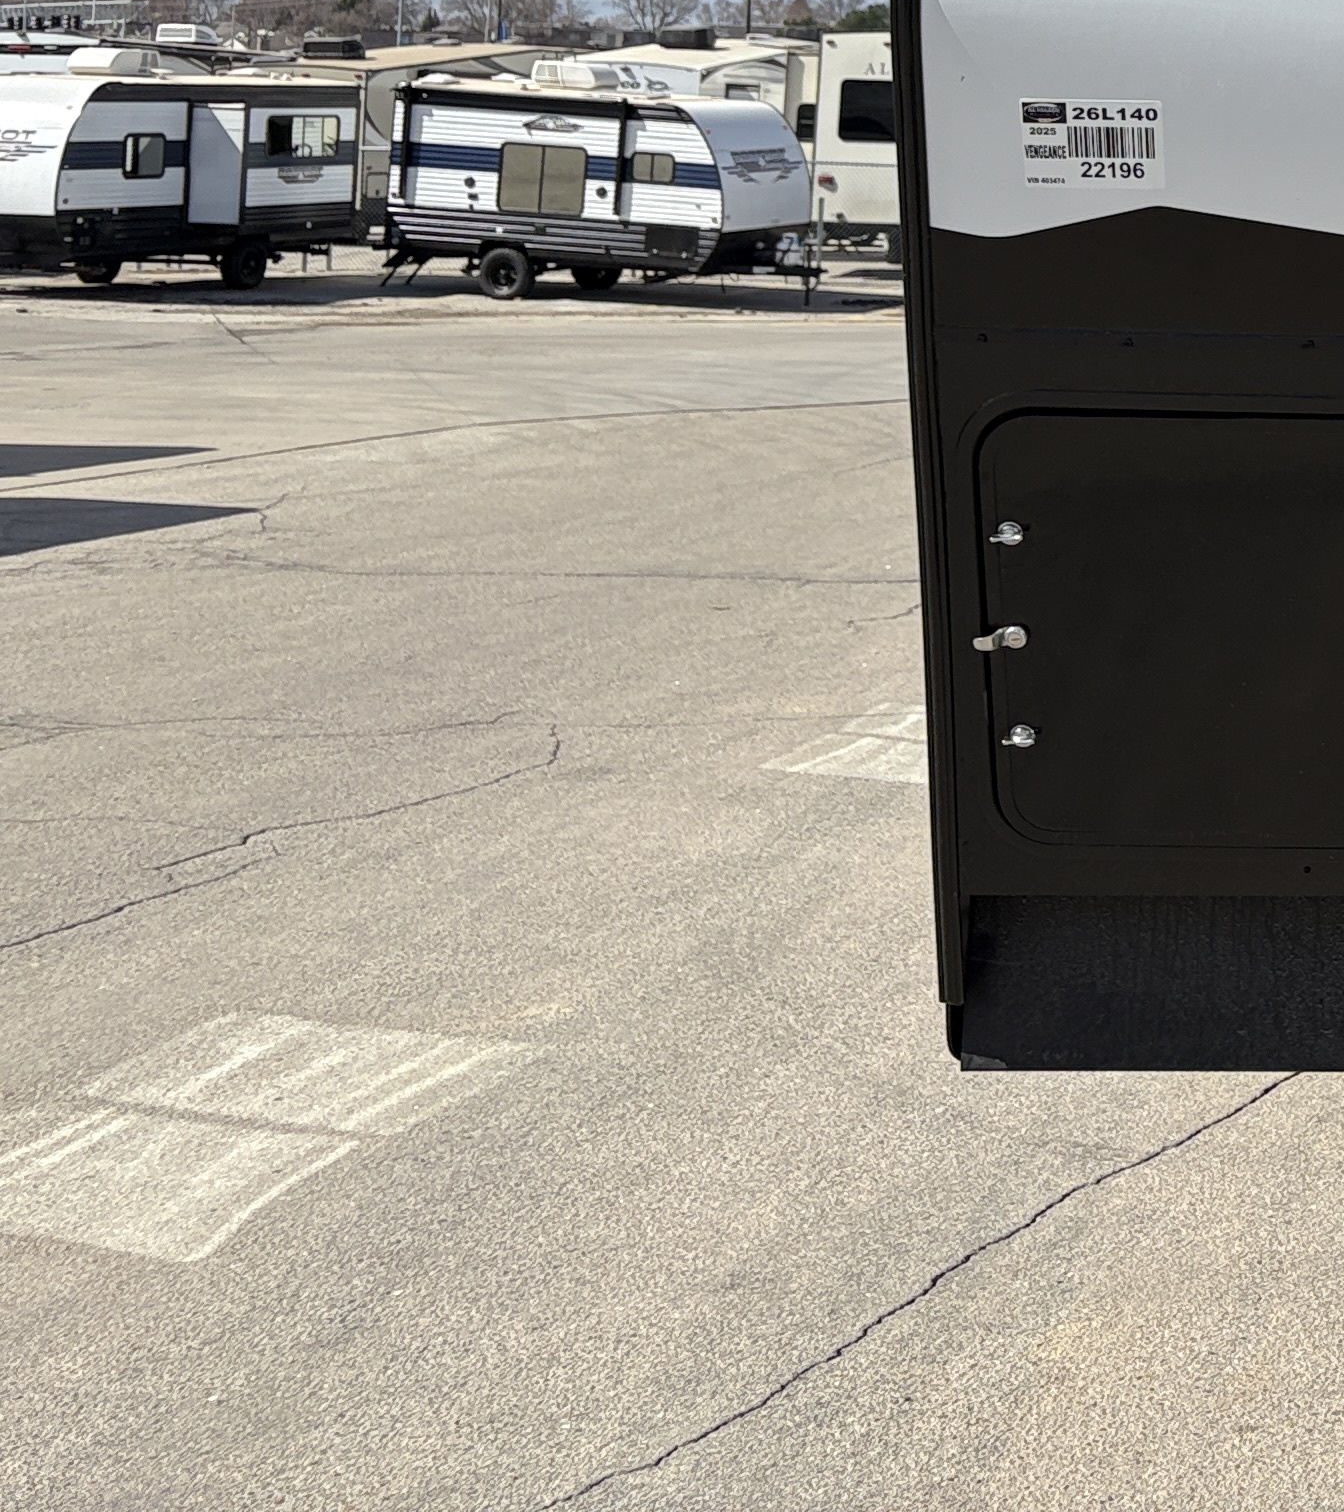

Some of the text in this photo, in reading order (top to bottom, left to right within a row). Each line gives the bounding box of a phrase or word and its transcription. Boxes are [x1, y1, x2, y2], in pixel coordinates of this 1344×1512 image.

[1071, 107, 1158, 122] 26L140
[0, 129, 37, 141] OT
[1029, 126, 1057, 136] 2025
[1024, 144, 1067, 160] VENGEANCE
[1080, 161, 1145, 179] 22196
